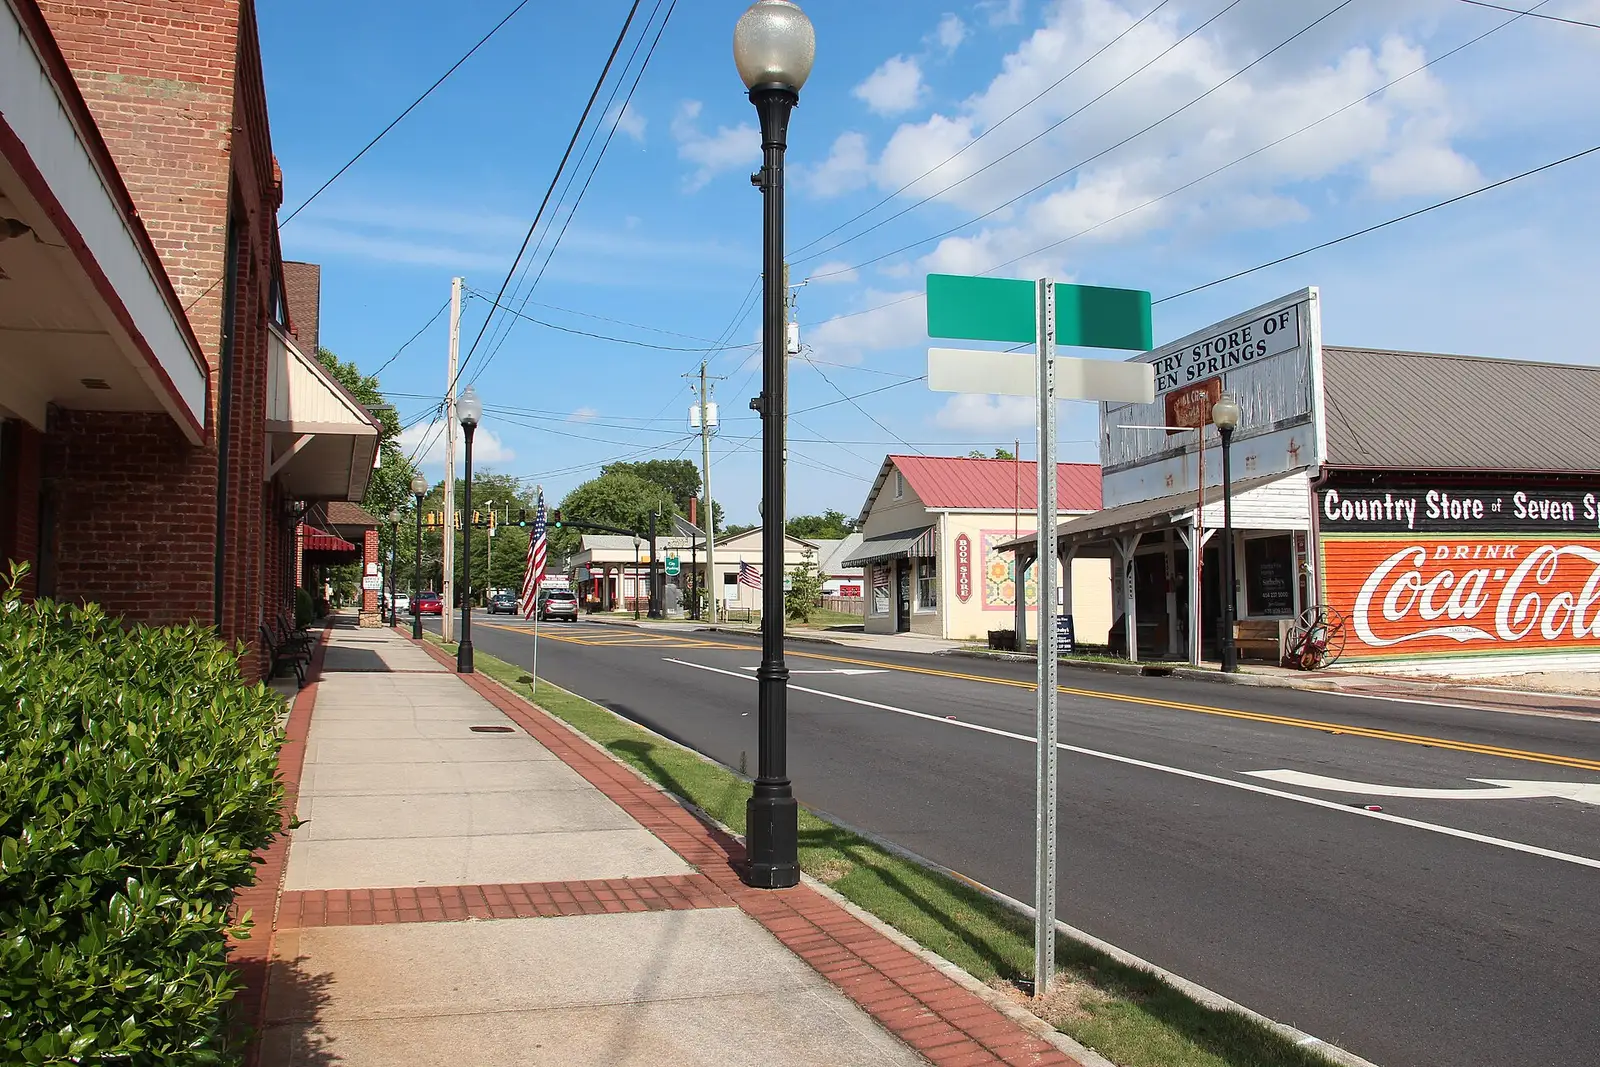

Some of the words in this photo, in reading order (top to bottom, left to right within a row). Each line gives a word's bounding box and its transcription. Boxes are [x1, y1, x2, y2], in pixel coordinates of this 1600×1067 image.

[1153, 352, 1184, 376] TRY
[1192, 326, 1253, 363] STORE
[1263, 311, 1290, 335] OF
[1154, 370, 1179, 392] EN
[1186, 339, 1267, 382] SPRINGS
[1324, 489, 1417, 530] Country
[1425, 489, 1484, 520] Store
[1491, 498, 1502, 513] of
[1513, 491, 1575, 522] Seven
[959, 540, 967, 564] BOOK
[1432, 544, 1519, 560] DRINK
[960, 566, 968, 596] STORE
[1353, 544, 1600, 647] Coca-Col
